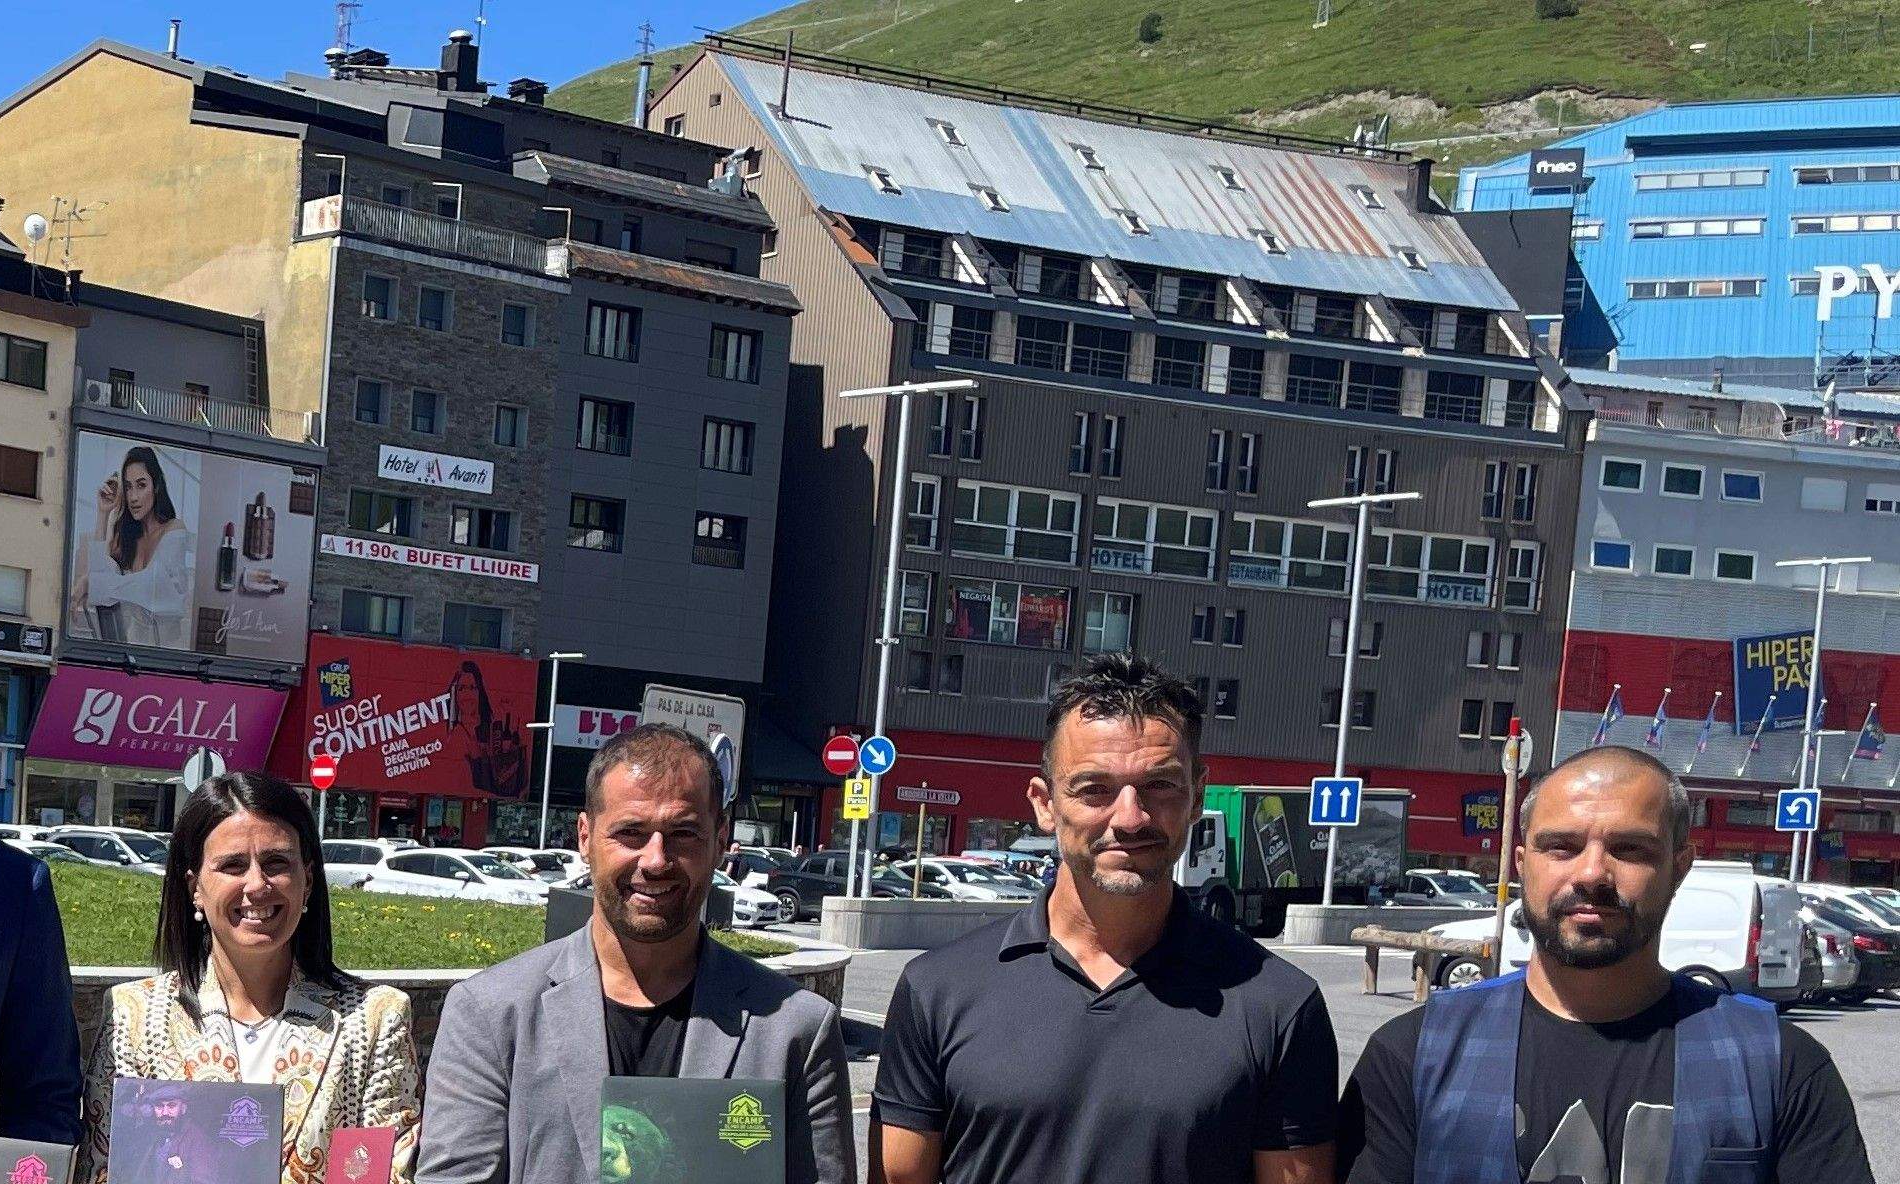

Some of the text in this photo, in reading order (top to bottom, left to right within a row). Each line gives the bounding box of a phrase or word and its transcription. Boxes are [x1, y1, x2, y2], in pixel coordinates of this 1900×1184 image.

[1536, 160, 1577, 174] fnac
[384, 453, 488, 485] Hotel Avanti
[406, 549, 465, 570] BUFET
[470, 557, 532, 579] LLIURE
[1747, 635, 1814, 669] HIPER
[320, 671, 350, 686] HIPER
[330, 685, 350, 699] PAS
[127, 694, 239, 743] GALA
[307, 692, 452, 766] CONTINENT
[313, 694, 382, 737] super
[381, 738, 410, 756] CAVA
[384, 738, 443, 767] DEGUSTACIÓ
[726, 1116, 765, 1125] ENCAMP
